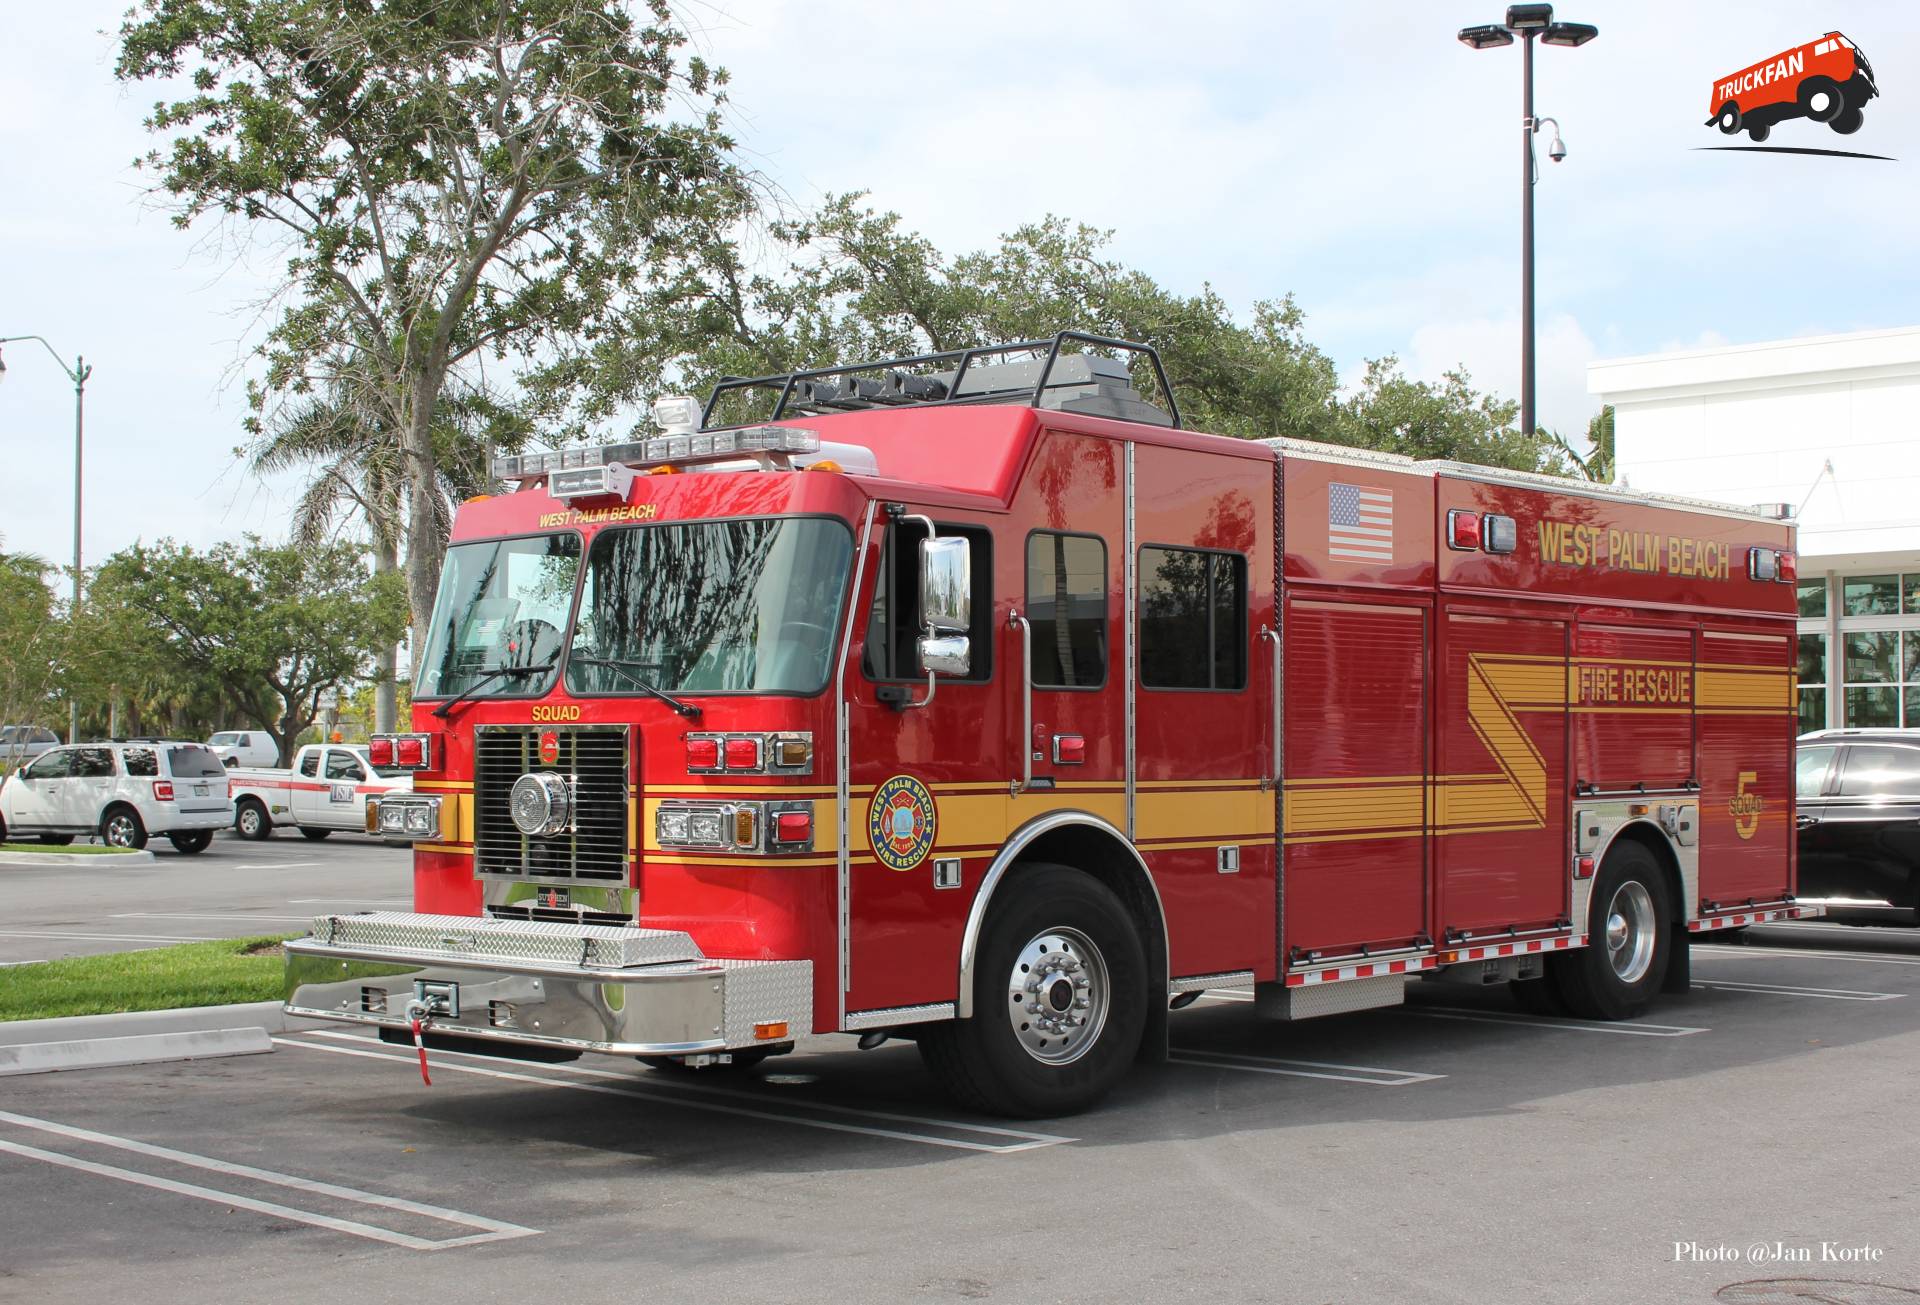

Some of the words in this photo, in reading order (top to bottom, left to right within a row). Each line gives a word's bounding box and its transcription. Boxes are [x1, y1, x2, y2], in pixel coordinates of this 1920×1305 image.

[539, 511, 572, 528] WEST
[573, 507, 609, 524] PALM
[609, 503, 657, 521] BEACH
[1537, 519, 1601, 568] WEST
[1607, 528, 1660, 573] PALM
[1666, 535, 1730, 581] BEACH
[1580, 665, 1618, 703] FIRE
[1623, 667, 1690, 703] RESCUE
[532, 705, 580, 721] SQUAD
[873, 790, 888, 821] WEST
[888, 780, 912, 792] PALM
[913, 784, 933, 820] BEACH
[1728, 793, 1763, 816] SQUAD
[1735, 771, 1757, 839] 5
[877, 842, 896, 864] FIRE
[896, 840, 928, 866] RESCUE
